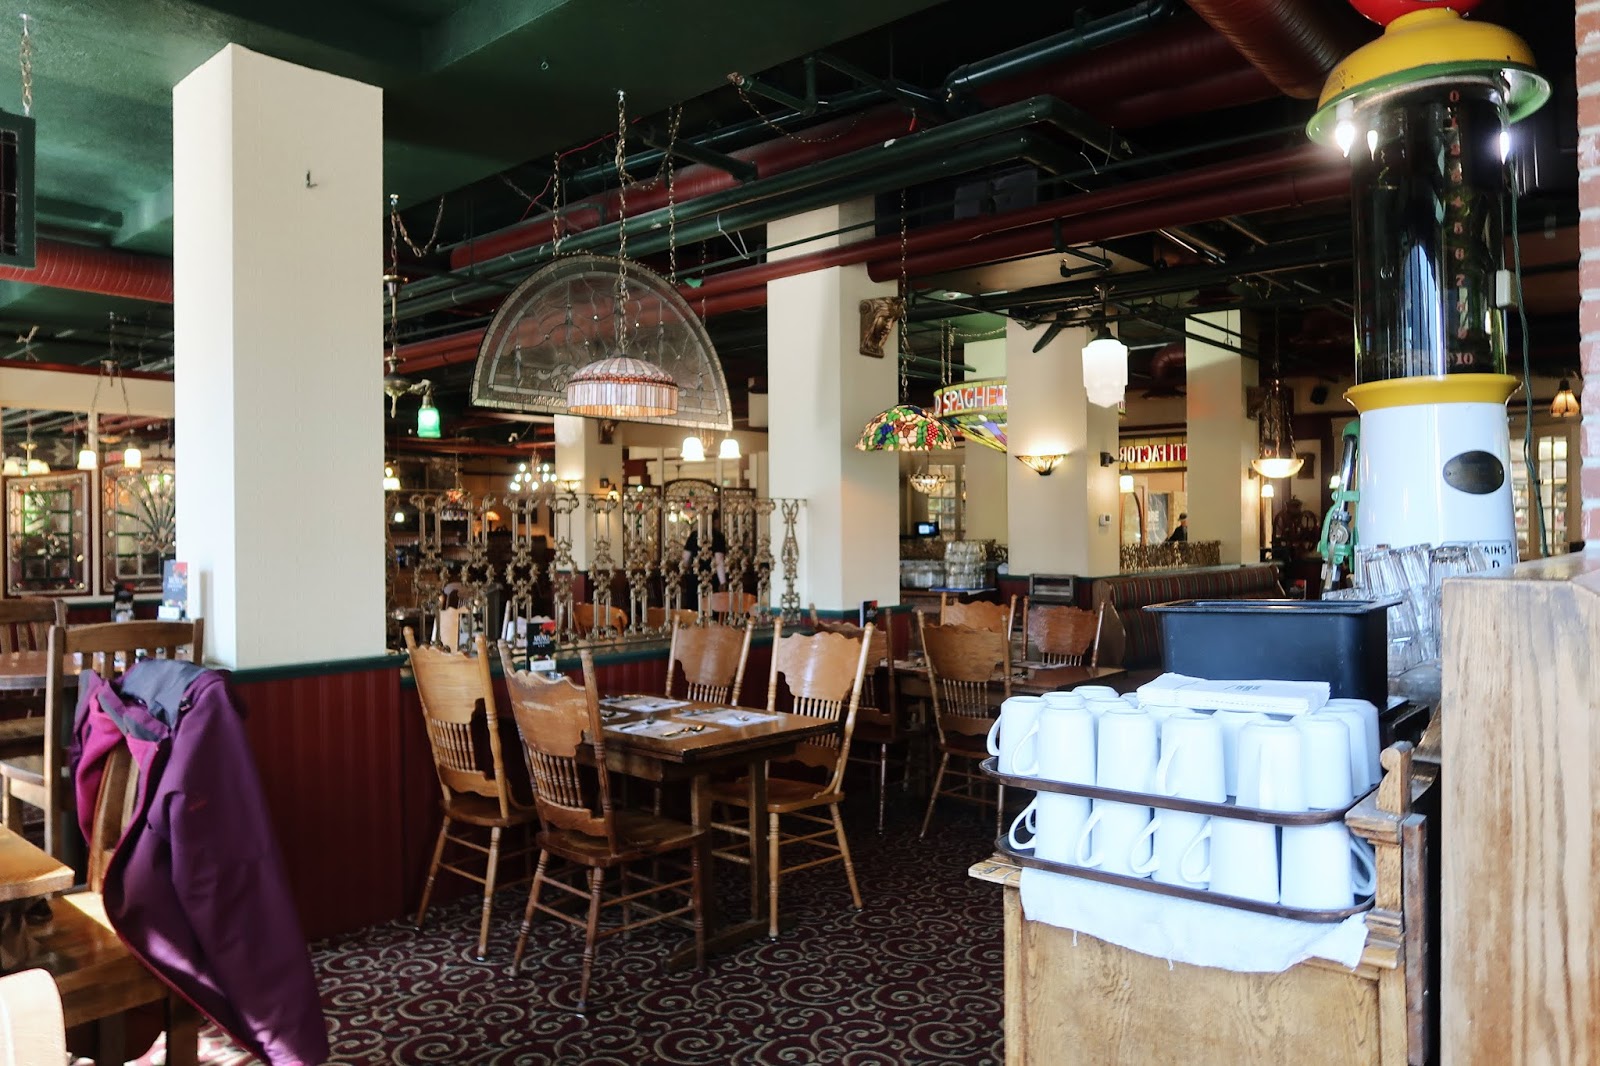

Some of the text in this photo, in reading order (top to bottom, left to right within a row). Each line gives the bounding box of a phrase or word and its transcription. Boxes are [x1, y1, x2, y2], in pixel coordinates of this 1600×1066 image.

[1449, 90, 1460, 102] 0
[1453, 222, 1463, 234] 5
[1455, 247, 1465, 260] 6
[1456, 273, 1466, 286] 7
[1456, 351, 1474, 365] 10
